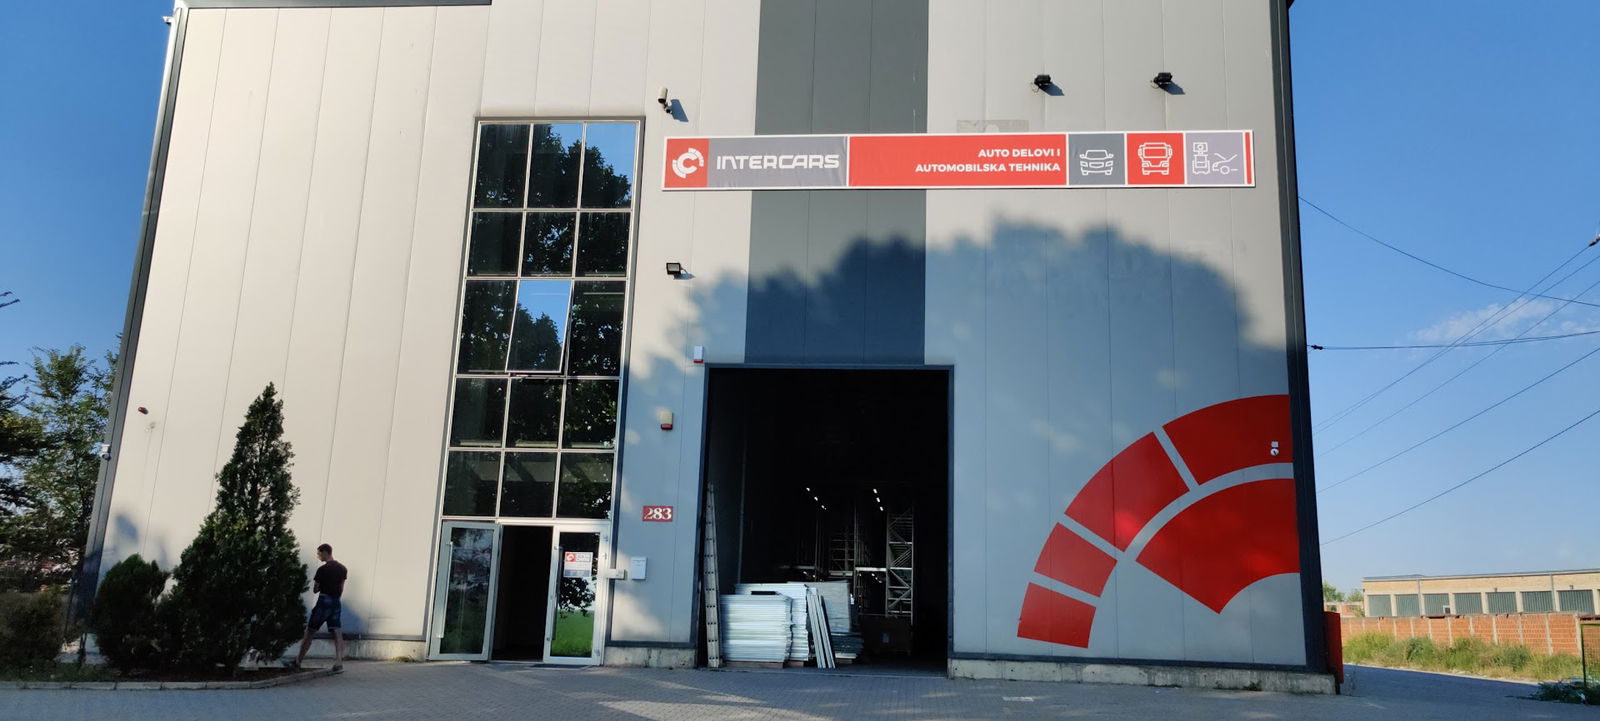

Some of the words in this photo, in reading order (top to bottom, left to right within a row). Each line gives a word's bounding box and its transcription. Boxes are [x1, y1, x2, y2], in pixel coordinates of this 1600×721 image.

[977, 148, 1010, 158] AUTO
[1012, 148, 1054, 157] DELOVI
[716, 154, 840, 170] INTERCARS
[915, 163, 1006, 173] AUTOMOBILSKA
[1008, 162, 1061, 172] TEHNIKA
[644, 507, 672, 520] 283
